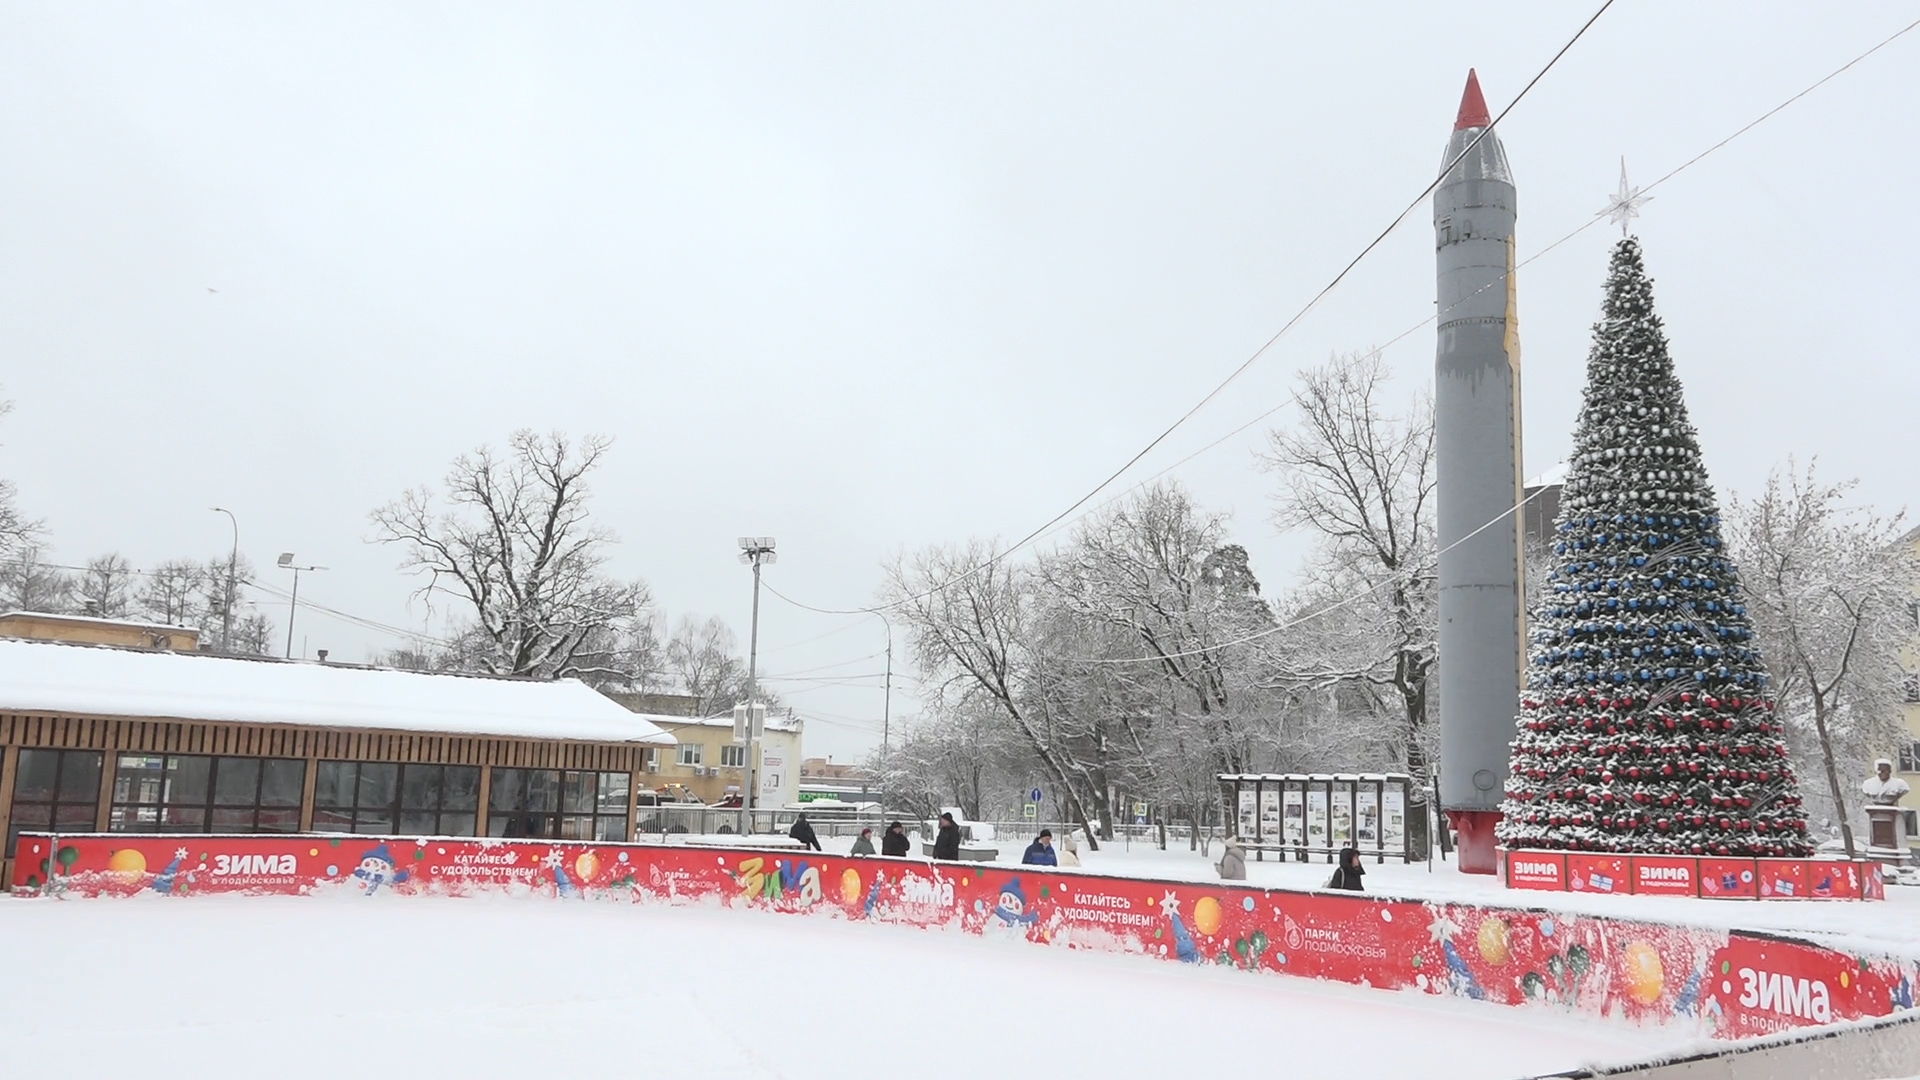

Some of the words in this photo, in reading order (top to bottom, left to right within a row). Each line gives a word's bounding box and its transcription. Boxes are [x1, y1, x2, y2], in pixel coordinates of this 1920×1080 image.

[441, 865, 538, 877] УДОВОЛЬСТВИЕМ!
[1514, 861, 1559, 876] ЗИМА
[1639, 866, 1690, 881] ЗИМА
[1074, 893, 1131, 909] КАТАЙТЕСЬ
[1063, 907, 1155, 927] УДОВОЛЬСТВИЕМ!
[1304, 928, 1341, 942] ПАРКИ
[1304, 940, 1387, 958] ПОДМОСКОВЬЯ
